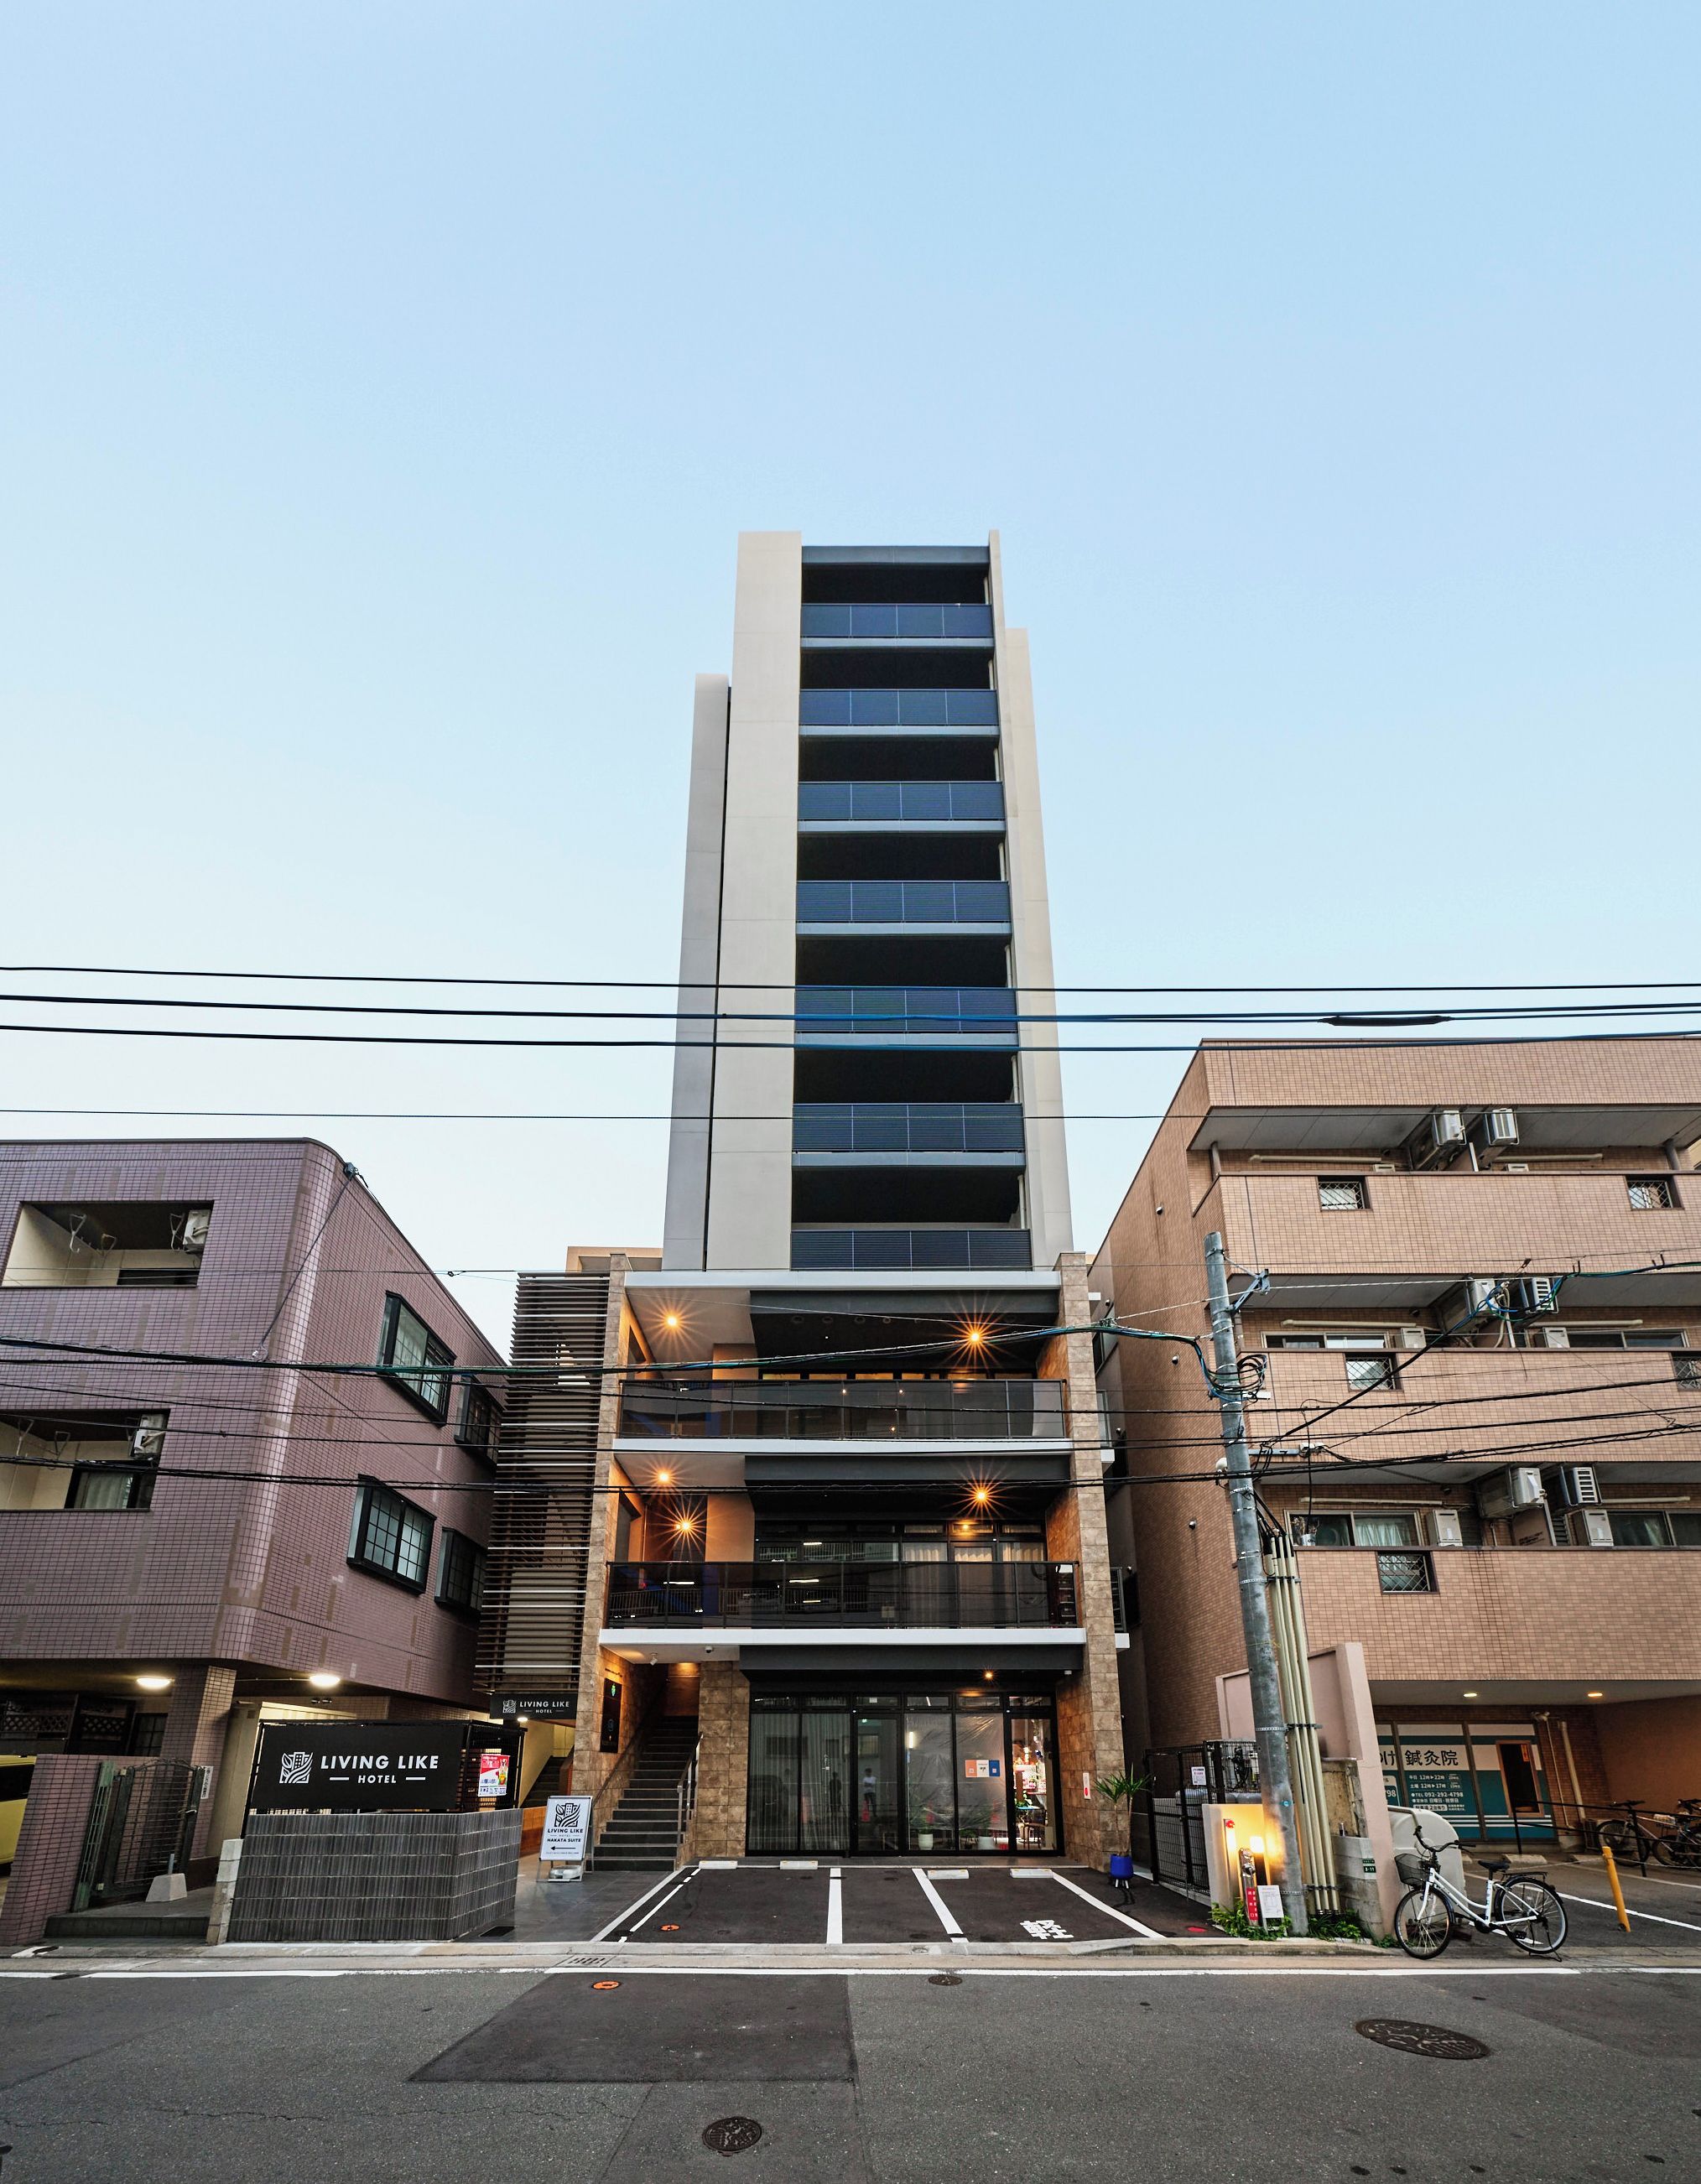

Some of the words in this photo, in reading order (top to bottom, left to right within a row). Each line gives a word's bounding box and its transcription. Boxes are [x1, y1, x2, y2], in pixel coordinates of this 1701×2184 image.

[320, 1755, 390, 1770] LIVING
[398, 1755, 440, 1770] LIKE
[1405, 1750, 1459, 1766] 鍼灸院
[357, 1775, 397, 1784] HOTEL
